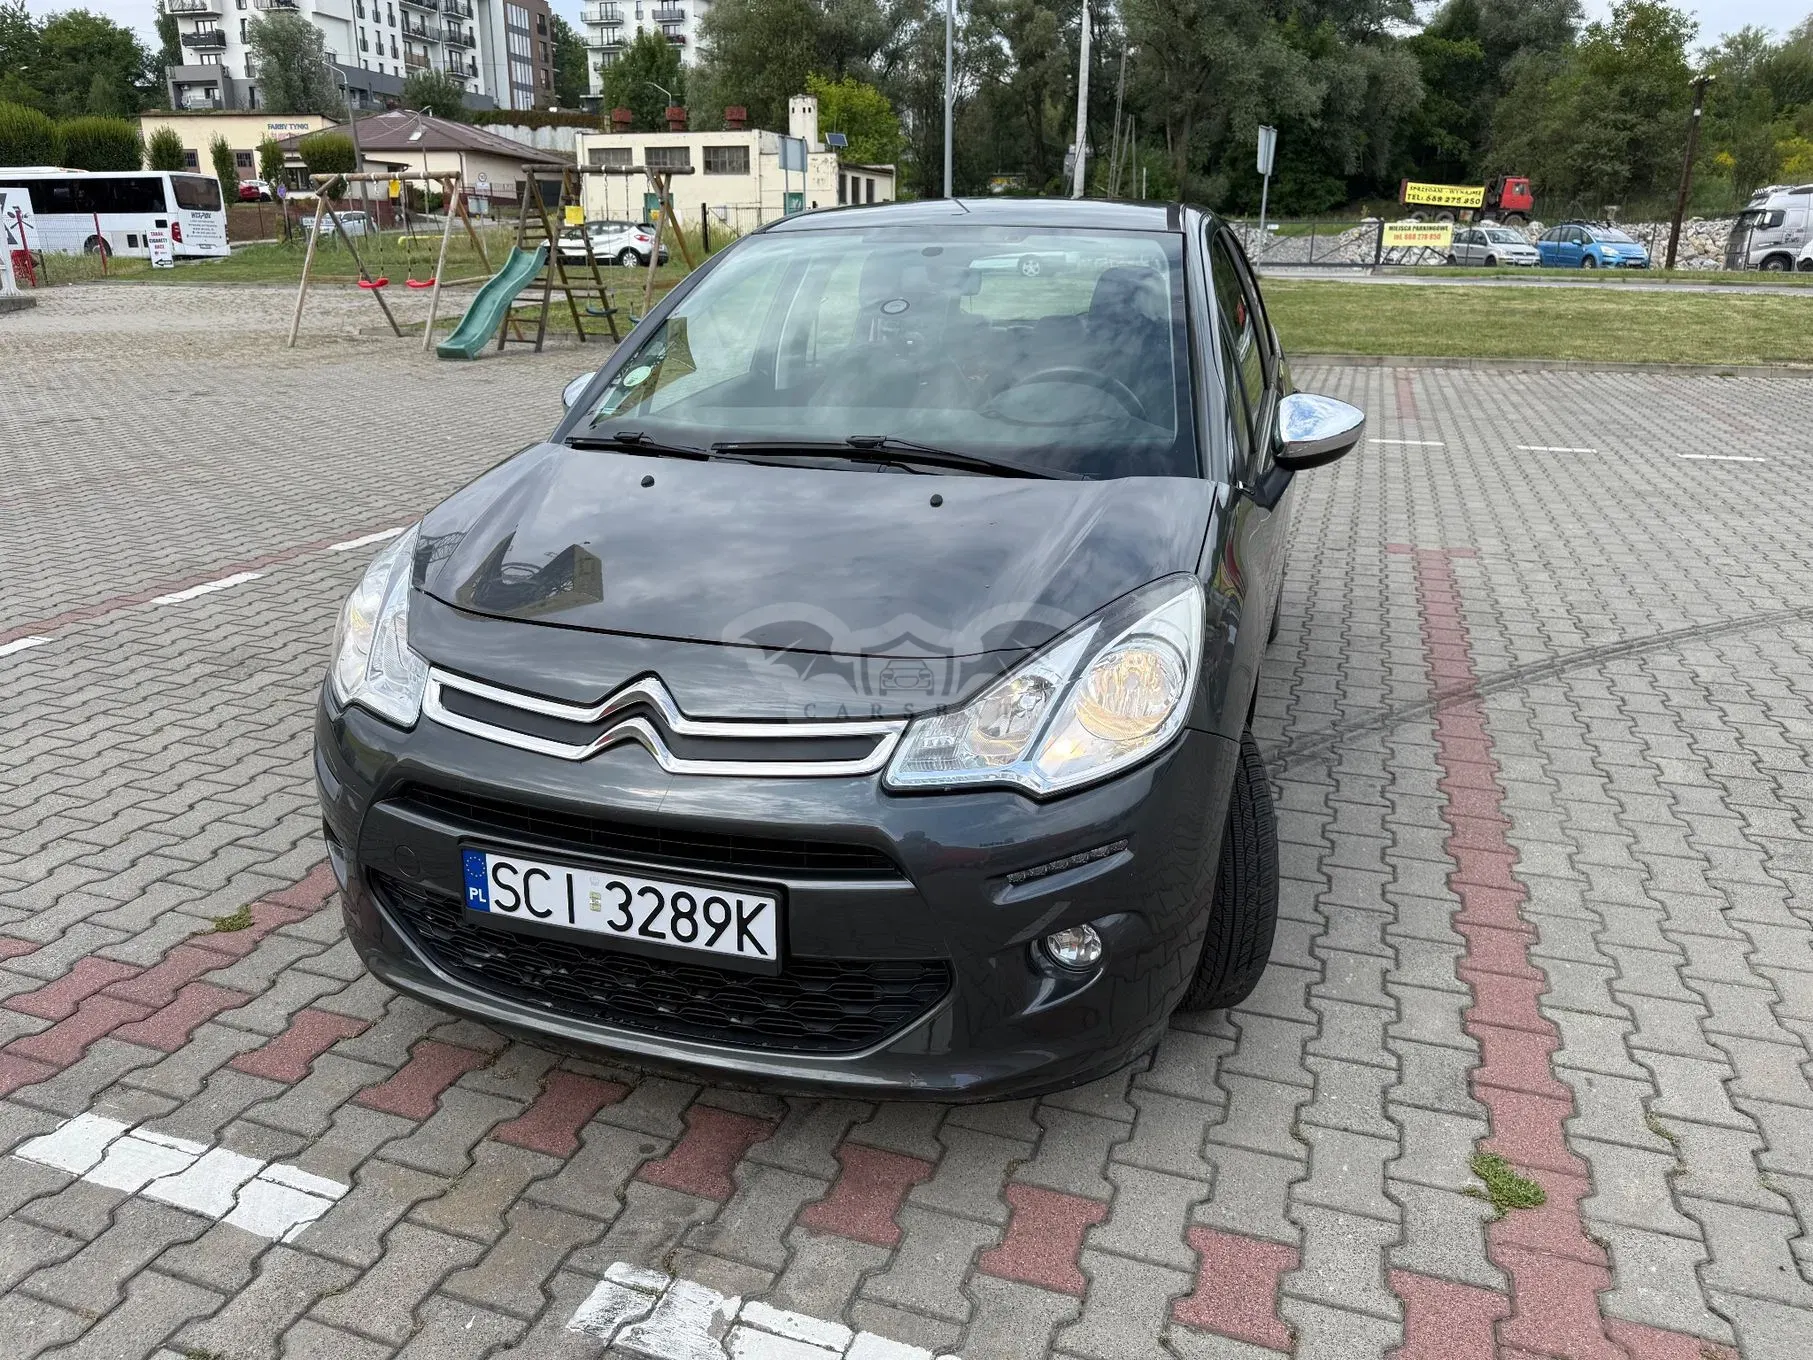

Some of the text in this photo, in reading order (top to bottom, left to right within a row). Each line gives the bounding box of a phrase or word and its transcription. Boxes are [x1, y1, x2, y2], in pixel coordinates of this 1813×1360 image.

[469, 886, 487, 903] PL
[491, 862, 768, 956] SCI 3289K
